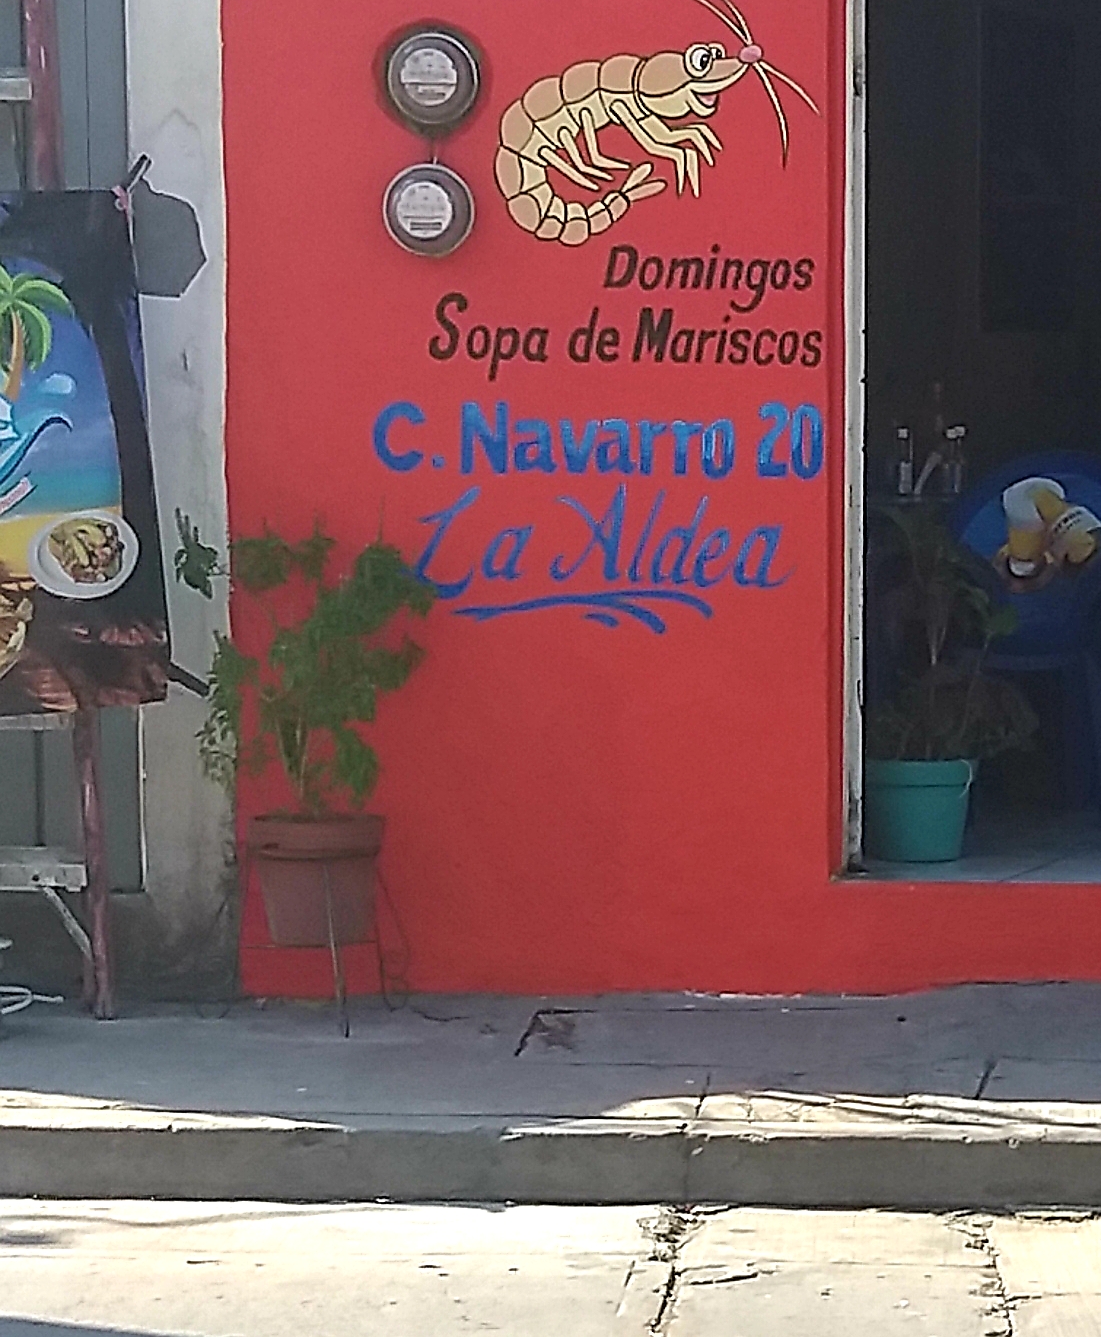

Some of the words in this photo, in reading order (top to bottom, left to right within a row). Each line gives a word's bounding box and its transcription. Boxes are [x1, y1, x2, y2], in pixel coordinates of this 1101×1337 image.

[603, 245, 815, 313] Domingos
[428, 292, 549, 382] Sopa
[568, 307, 621, 363] de
[631, 307, 824, 369] Mariscos
[372, 402, 446, 471] C.
[460, 401, 736, 480] Navarro
[756, 401, 826, 480] 20
[402, 485, 534, 599] La
[549, 483, 796, 590] Aldea
